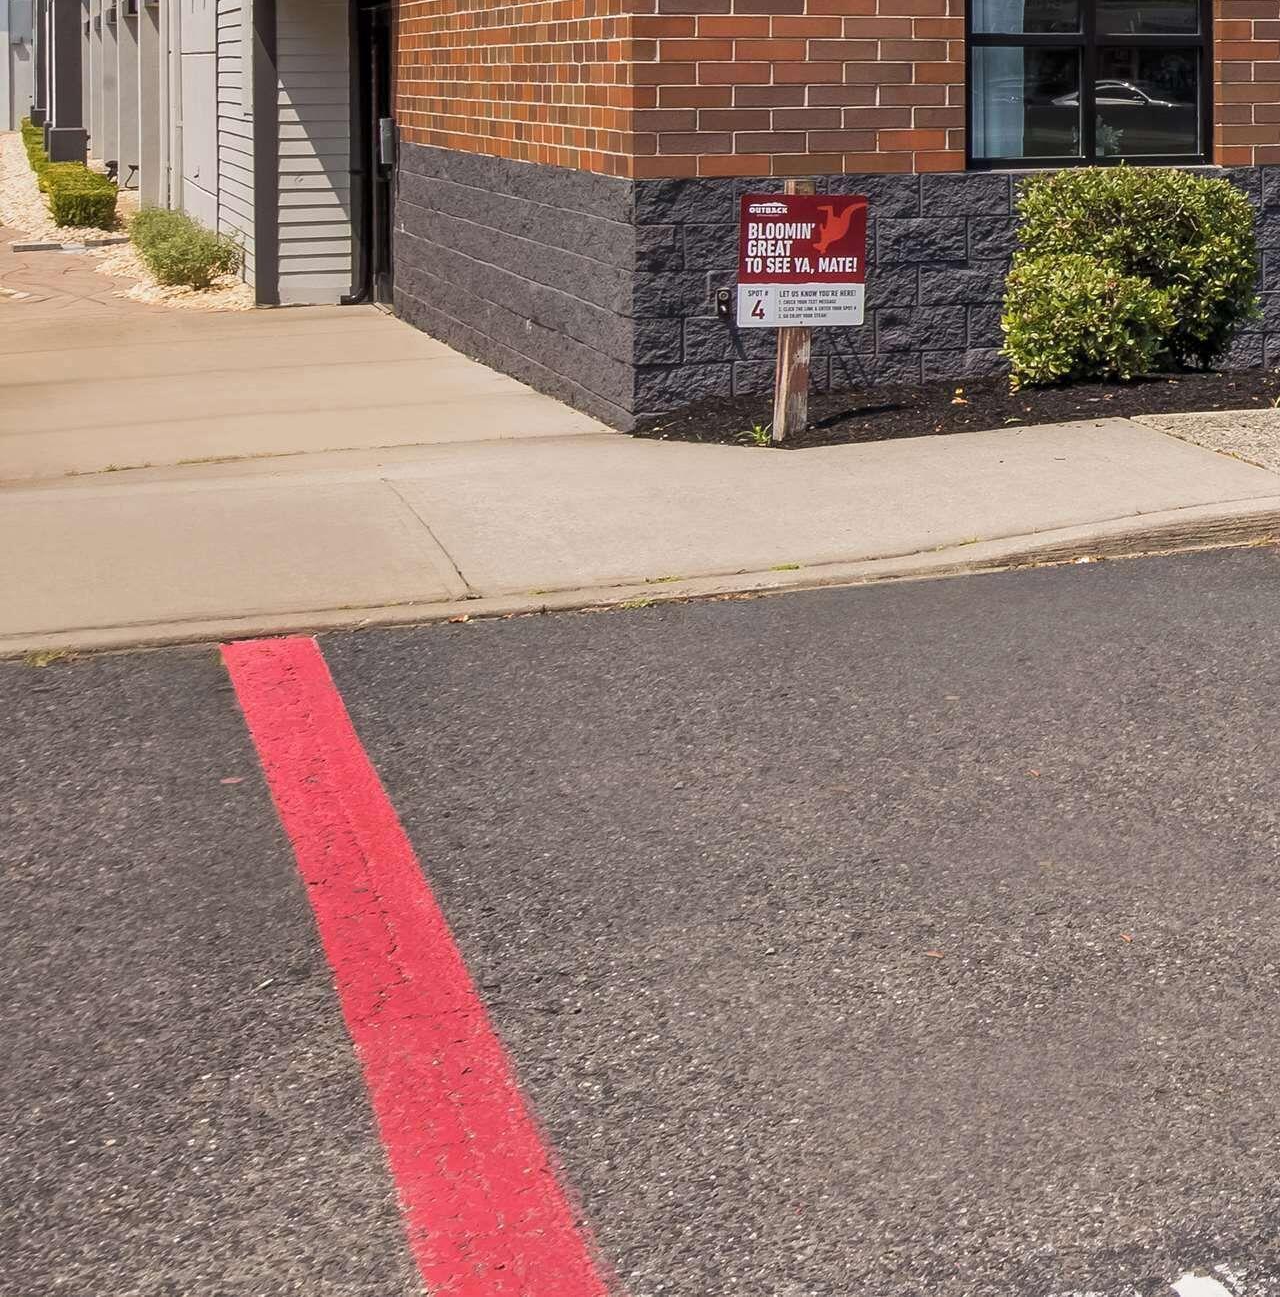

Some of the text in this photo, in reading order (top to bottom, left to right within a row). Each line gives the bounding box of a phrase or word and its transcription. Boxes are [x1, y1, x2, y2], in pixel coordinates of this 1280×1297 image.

[748, 222, 816, 240] BLOOMIN'
[748, 239, 793, 257] GREAT
[745, 256, 857, 275] TO SEE YA, MATE!
[747, 289, 763, 297] SPOT
[779, 290, 790, 298] LET
[751, 299, 765, 320] 4
